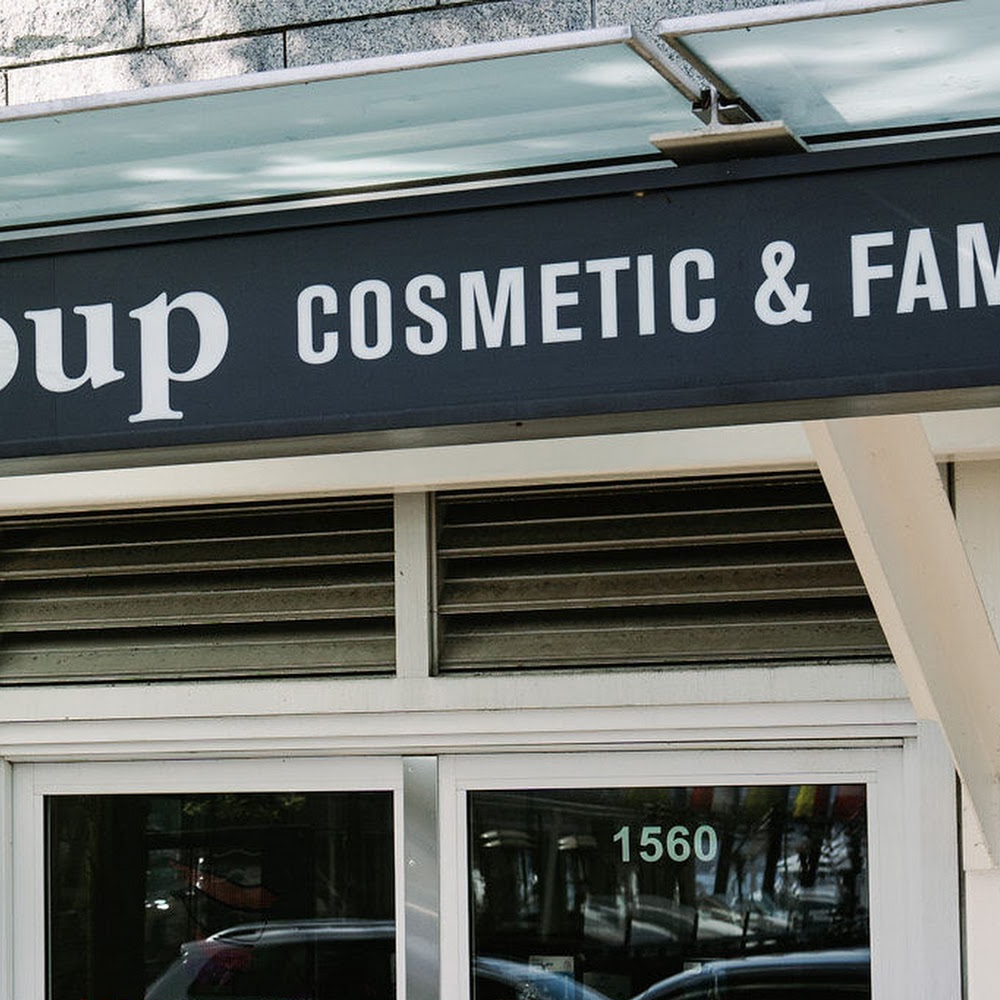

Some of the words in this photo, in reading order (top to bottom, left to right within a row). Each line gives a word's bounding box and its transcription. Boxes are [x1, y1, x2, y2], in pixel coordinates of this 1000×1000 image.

[297, 248, 716, 364] COSMETIC
[754, 240, 812, 325] &
[613, 824, 718, 863] 1560
